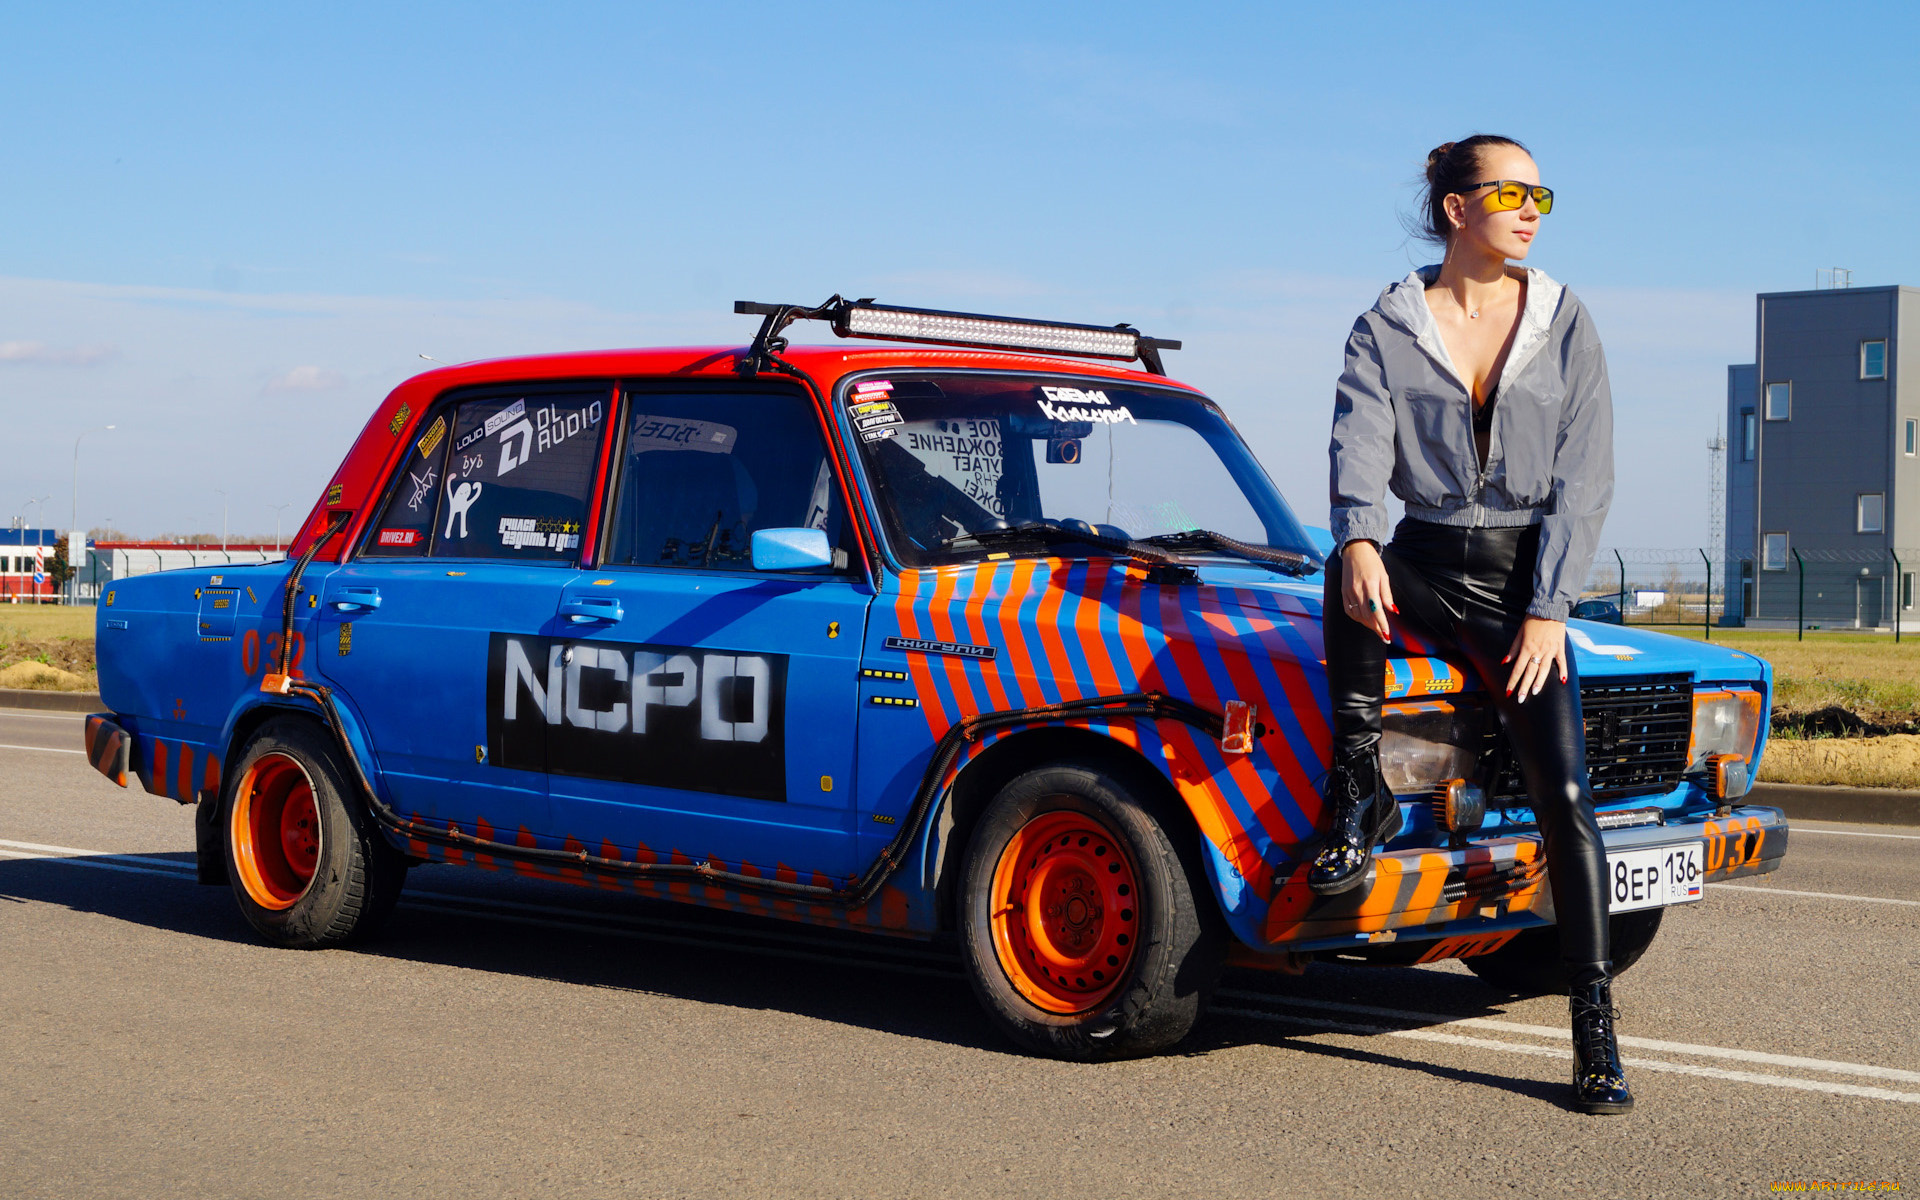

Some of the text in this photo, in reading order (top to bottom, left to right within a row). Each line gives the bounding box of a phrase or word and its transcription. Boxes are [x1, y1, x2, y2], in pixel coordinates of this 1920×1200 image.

[457, 428, 484, 451] LOUD
[486, 403, 523, 432] SOUND
[536, 403, 562, 432] DL
[538, 400, 602, 453] AUDIO
[862, 414, 895, 428] ДОЛГОСТРОЙ
[421, 419, 443, 448] DANGER
[408, 472, 438, 512] УРАЛ
[380, 530, 414, 544] DRIVE2.RU
[896, 639, 985, 655] ЖИГУЛИ
[1607, 850, 1697, 905] 8ЕР 136
[1671, 884, 1688, 897] RUS
